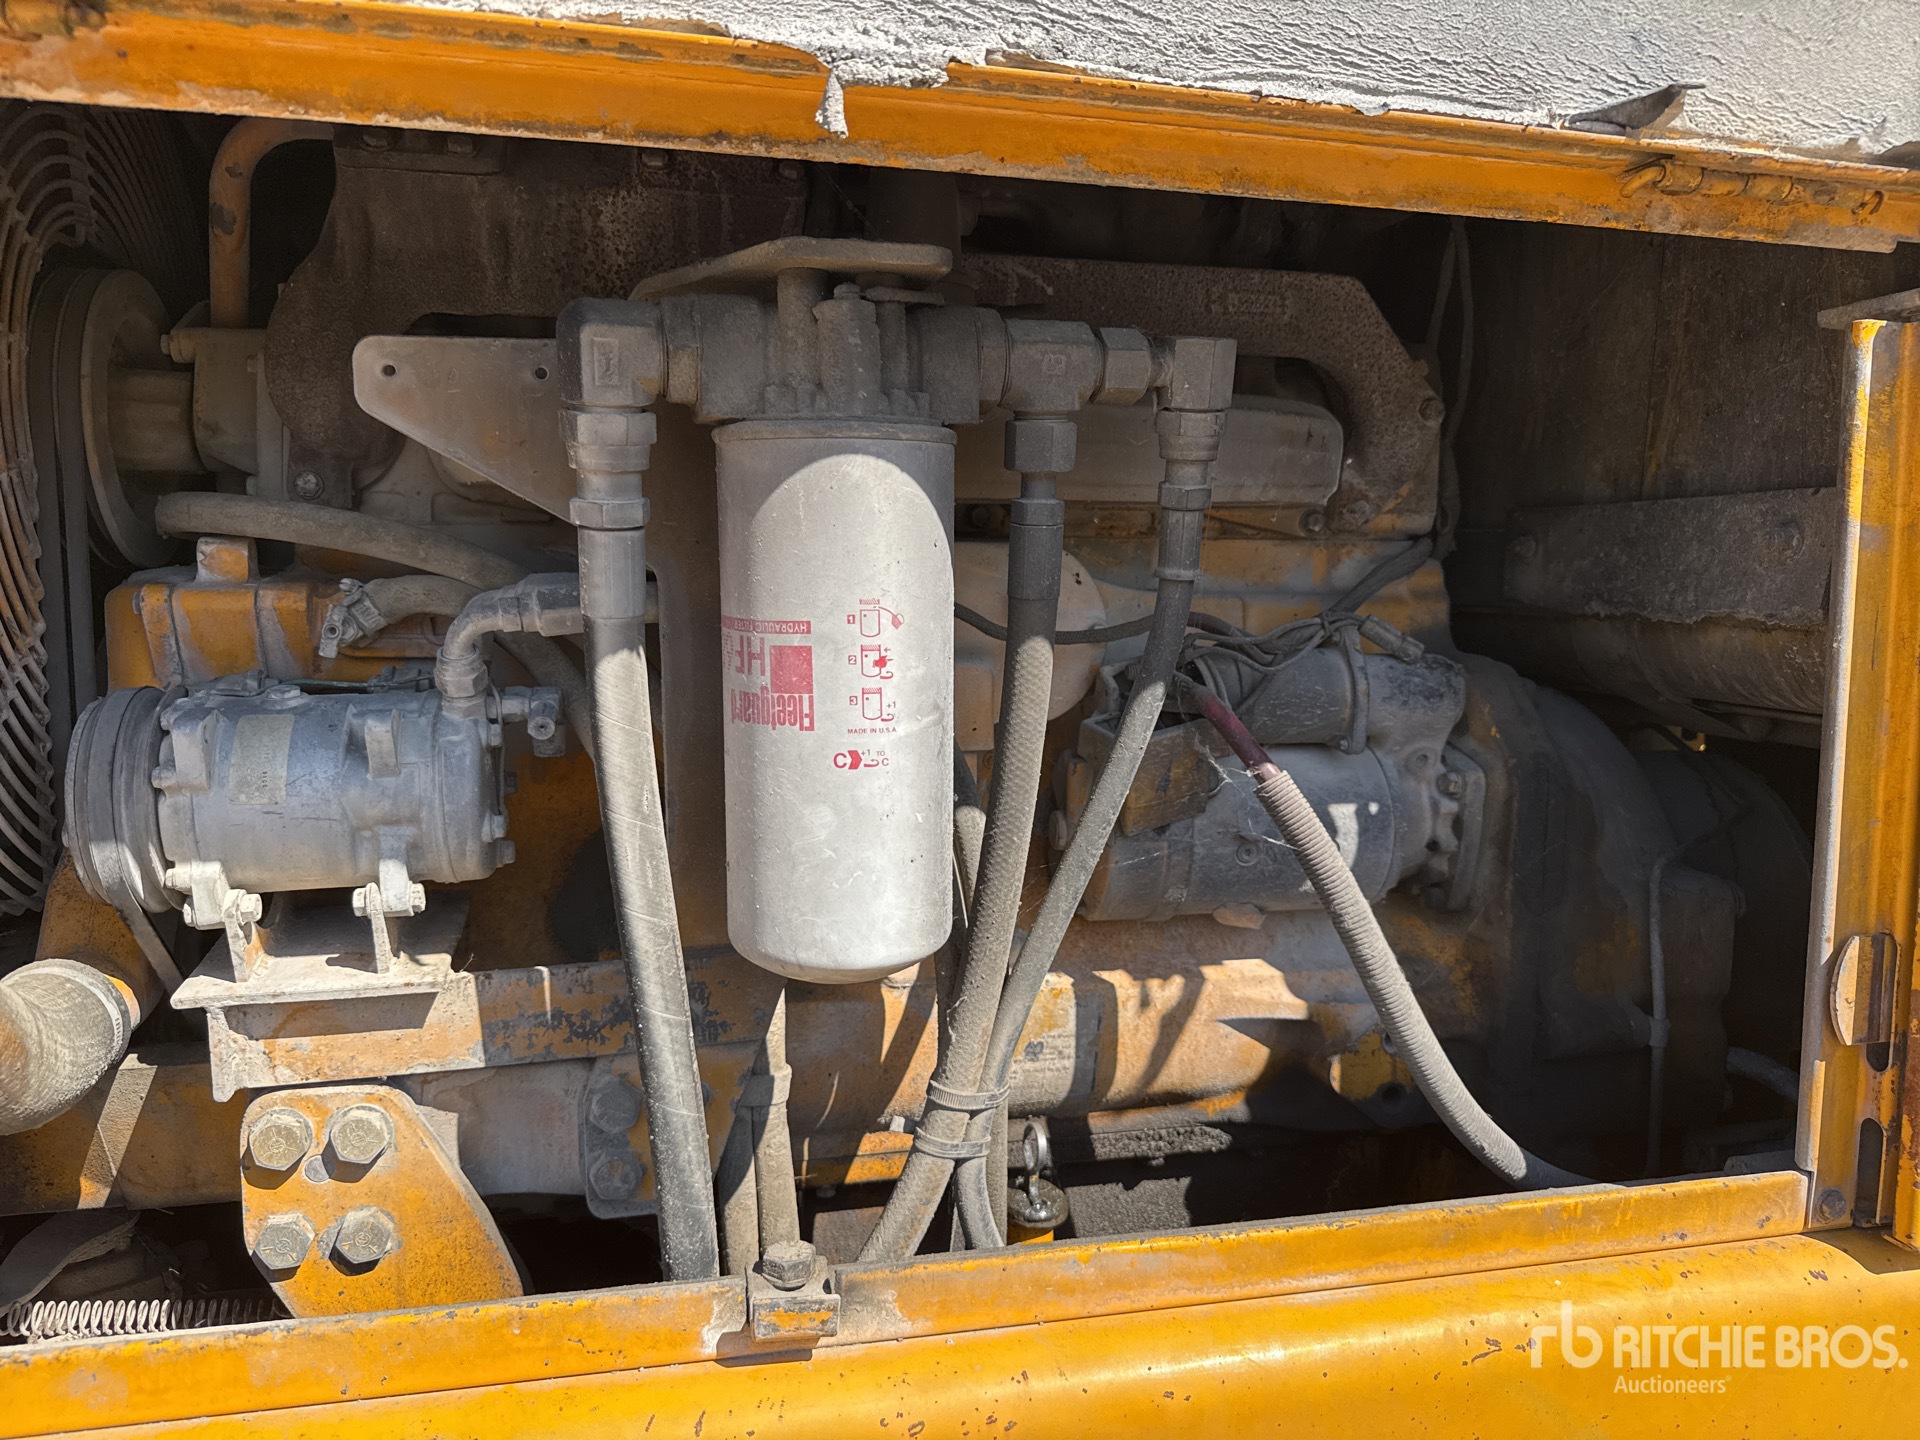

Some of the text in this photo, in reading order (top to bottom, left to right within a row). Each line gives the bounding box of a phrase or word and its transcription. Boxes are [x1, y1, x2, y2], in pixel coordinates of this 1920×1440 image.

[755, 621, 807, 633] HYDRAULIC
[735, 635, 766, 677] HF
[849, 656, 856, 664] 2
[850, 697, 857, 705] 3
[731, 685, 815, 732] Fleetguard
